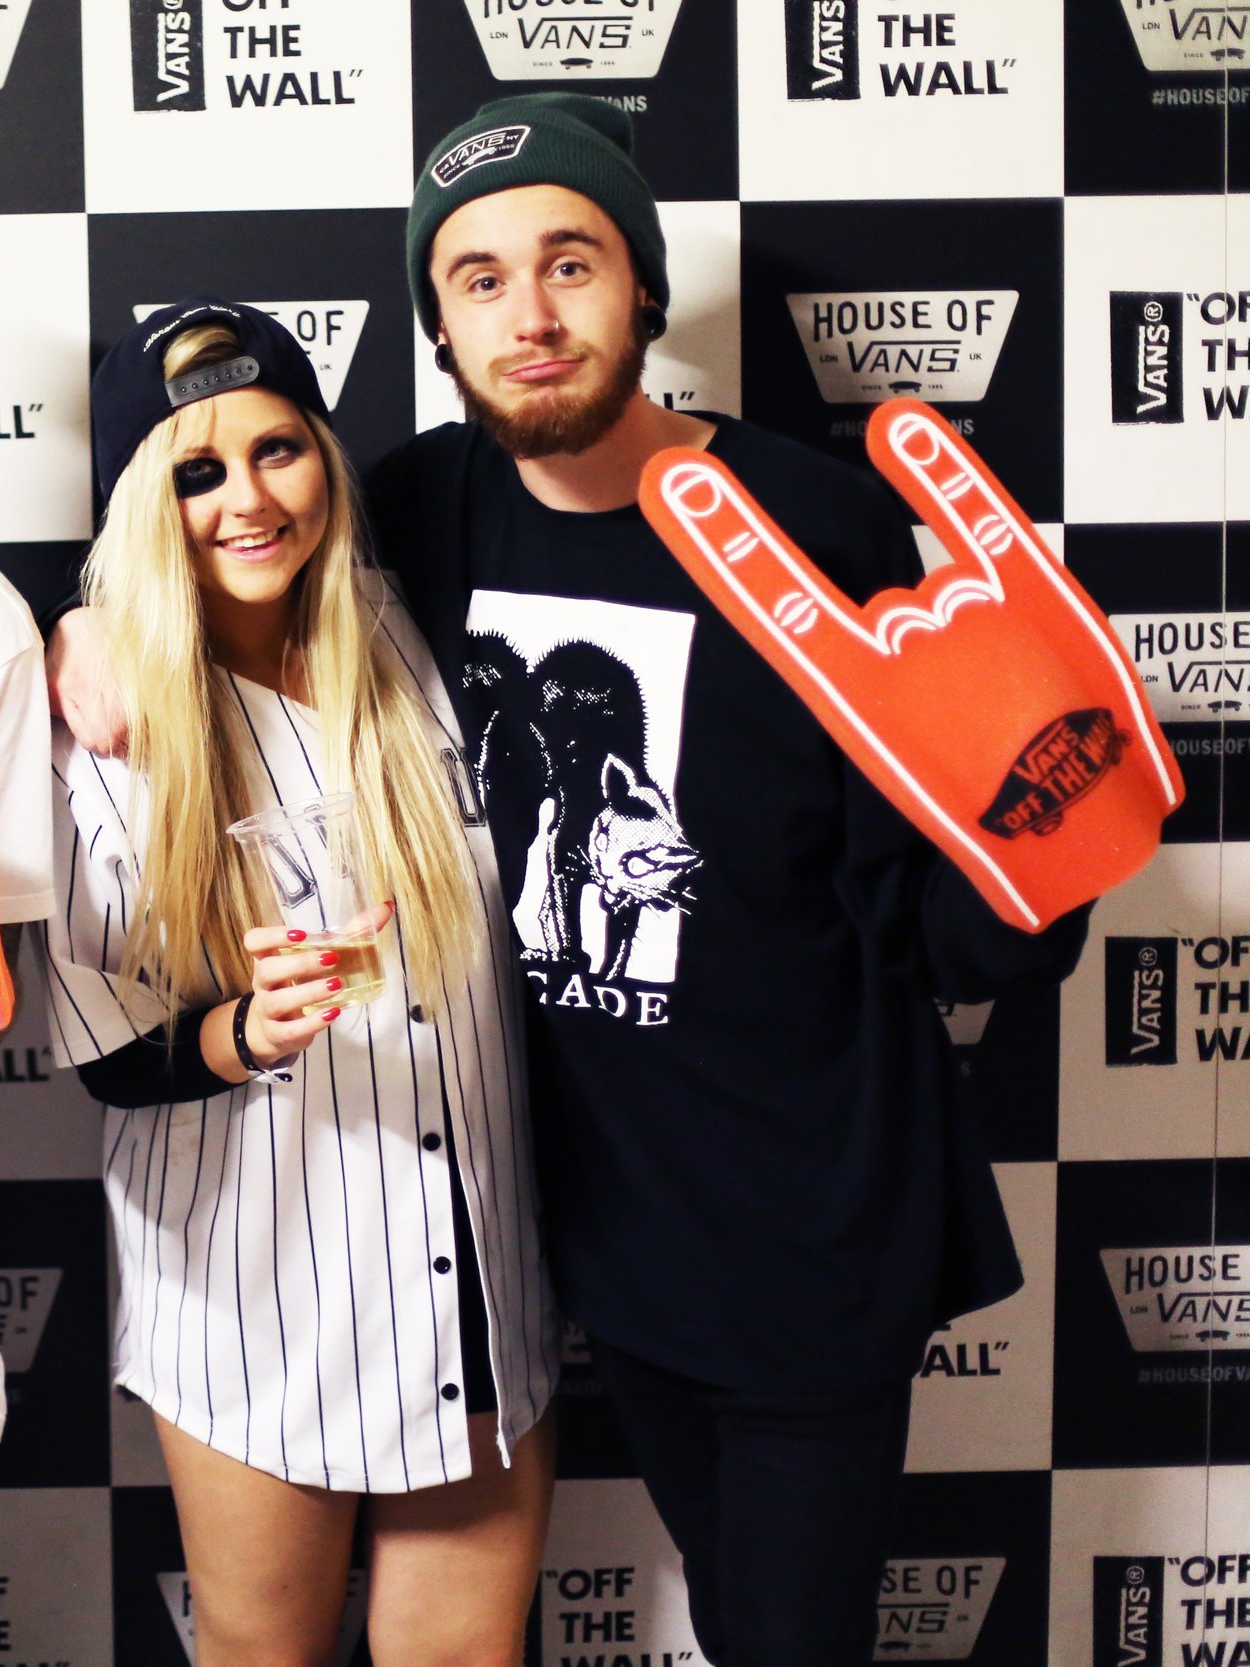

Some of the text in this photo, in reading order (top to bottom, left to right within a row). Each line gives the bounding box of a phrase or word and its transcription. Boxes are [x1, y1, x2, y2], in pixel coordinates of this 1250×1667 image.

[223, 24, 302, 59] THE
[490, 31, 509, 39] LDN
[517, 16, 633, 50] VANS
[877, 13, 956, 48] THE
[1142, 22, 1161, 30] LDN
[448, 132, 506, 165] VANS
[297, 310, 344, 346] OF
[813, 299, 995, 342] HOUSE OF
[820, 340, 982, 373] LDN VANS UK
[1135, 620, 1250, 663] HOUSE
[1167, 660, 1250, 693] VAN
[1013, 719, 1079, 784] VANS
[1041, 751, 1095, 801] THE
[1125, 1254, 1241, 1295] HOUSE
[936, 1565, 983, 1599] OF
[559, 1611, 635, 1644] THE
